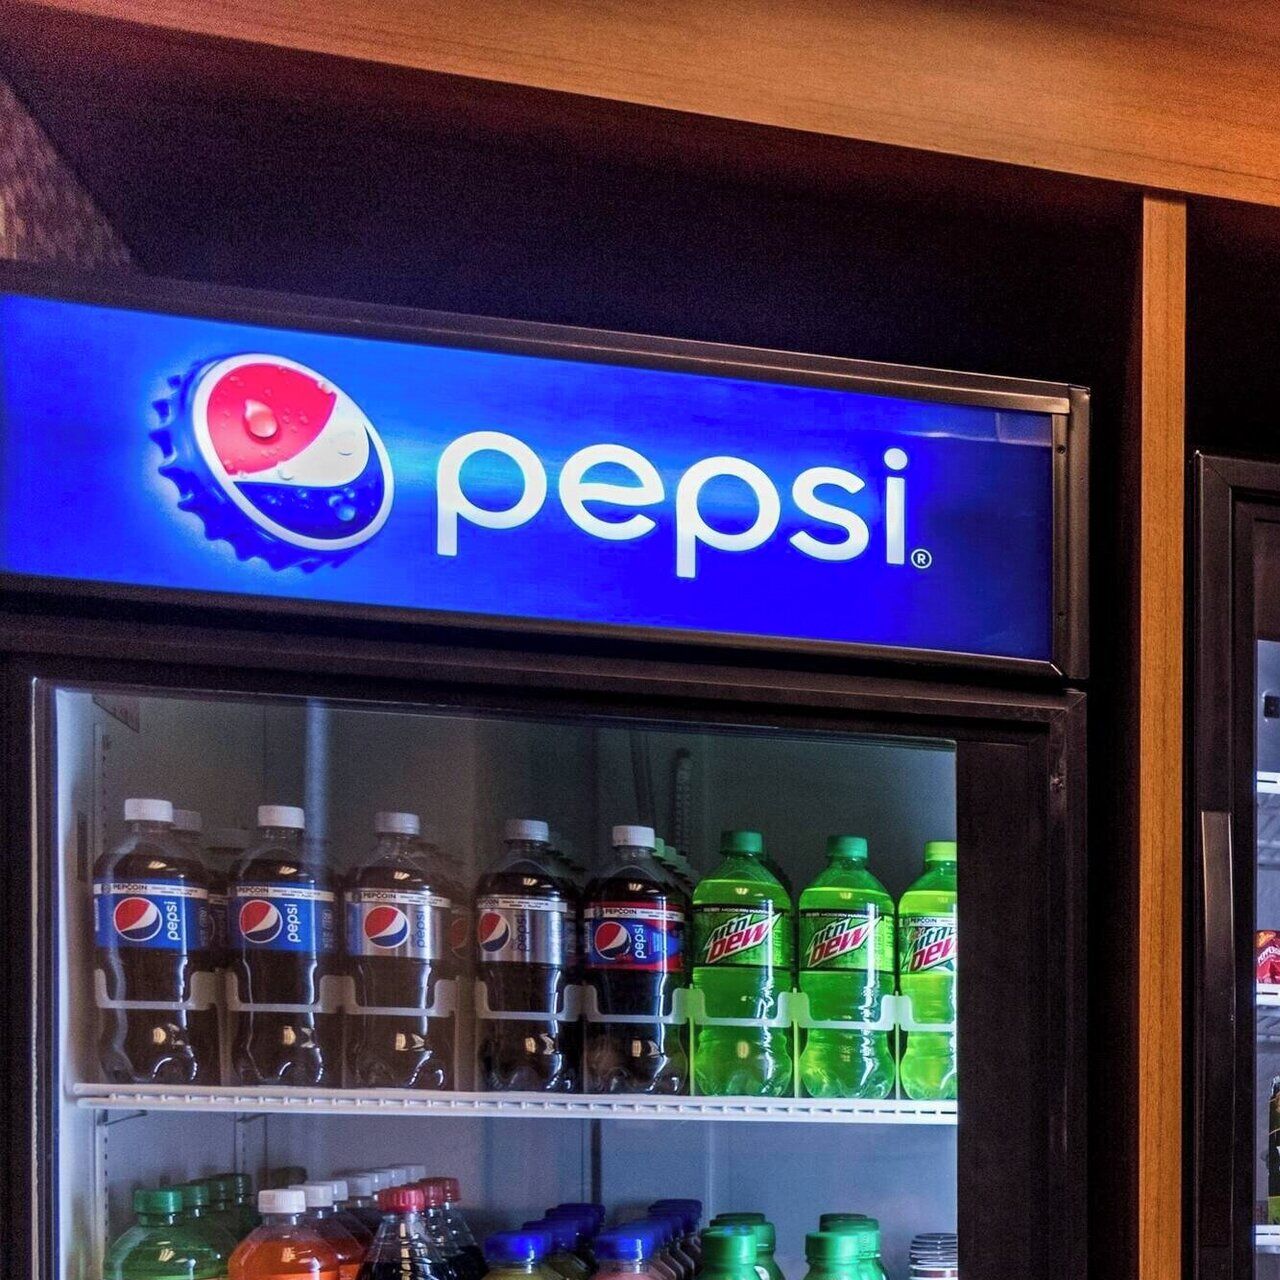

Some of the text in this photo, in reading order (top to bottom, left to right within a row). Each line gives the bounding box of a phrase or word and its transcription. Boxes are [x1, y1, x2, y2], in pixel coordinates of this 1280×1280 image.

[437, 430, 908, 579] pepsi
[166, 901, 181, 941] pepsi
[287, 903, 301, 943] pepsi
[417, 910, 427, 949] pepsi
[634, 924, 645, 960] pepsi
